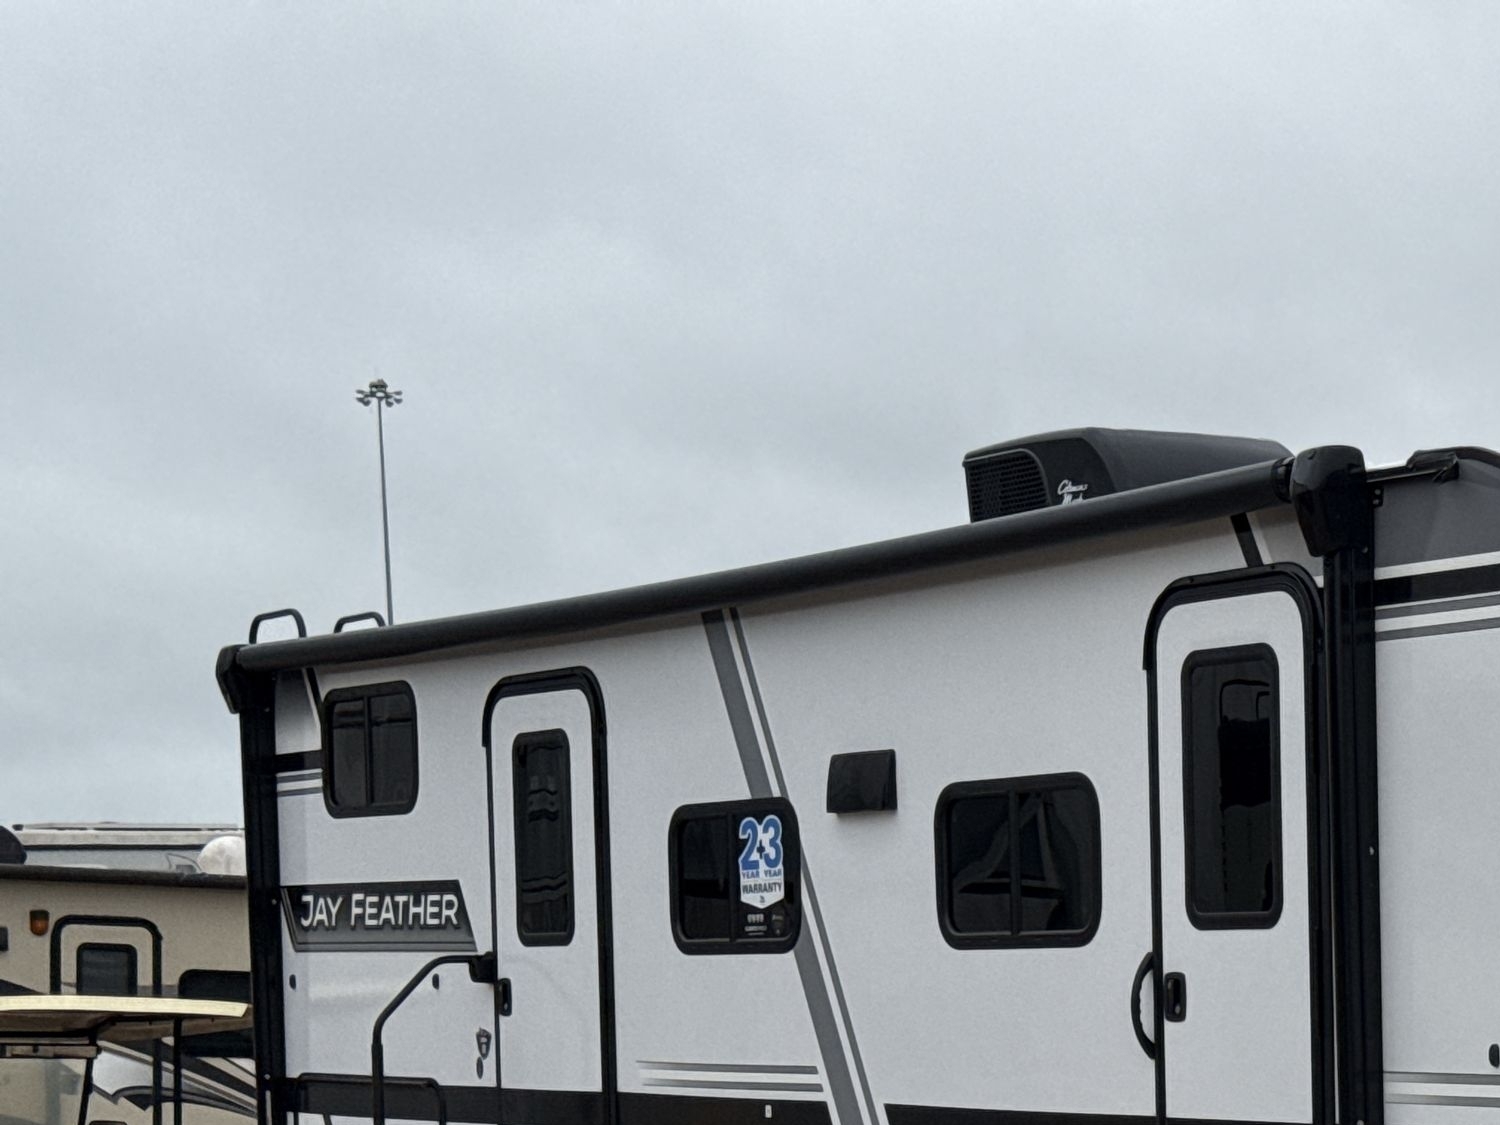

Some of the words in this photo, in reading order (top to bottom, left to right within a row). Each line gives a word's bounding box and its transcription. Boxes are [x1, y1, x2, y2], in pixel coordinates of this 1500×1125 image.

[742, 882, 783, 895] WARRANTY
[300, 895, 343, 927] JAY
[350, 893, 459, 926] FEATHER
